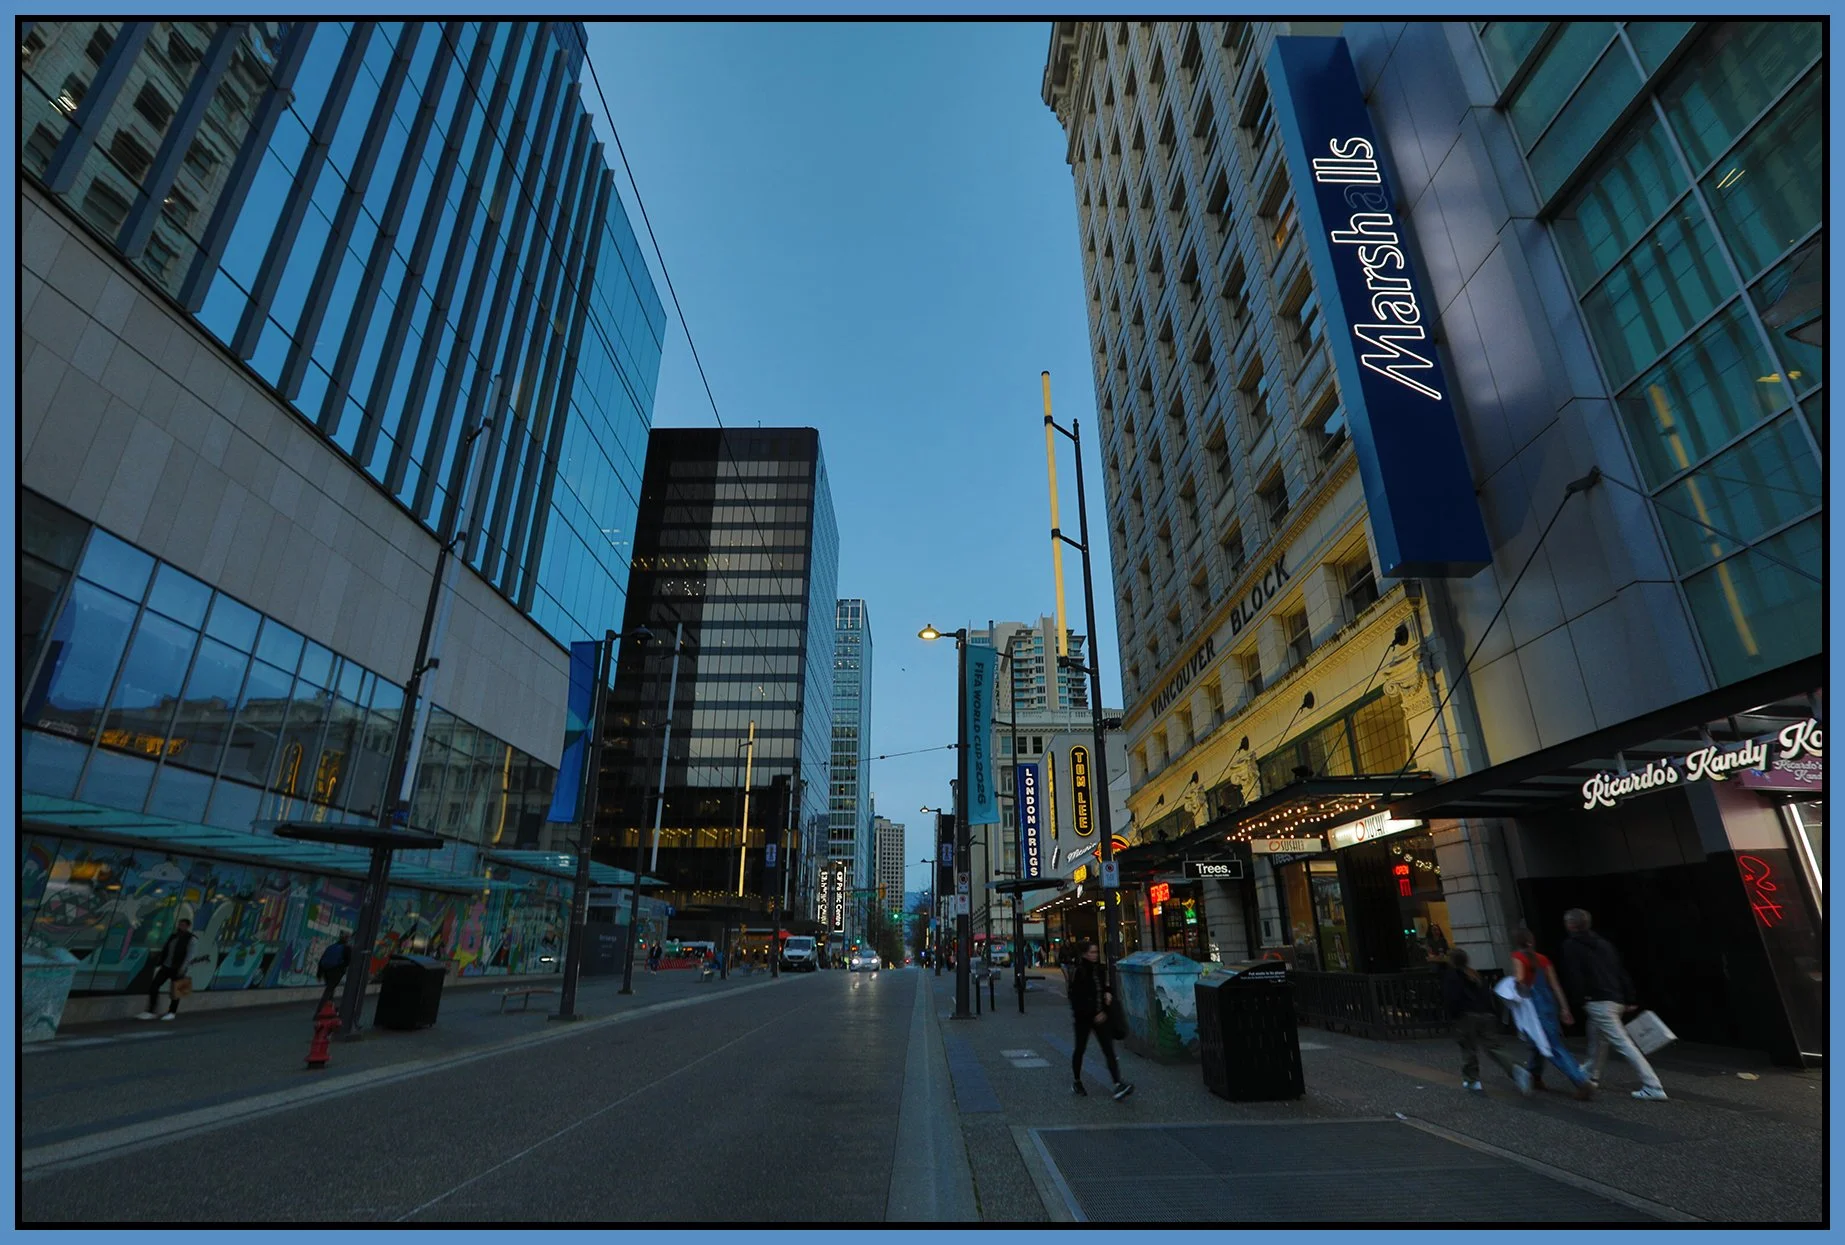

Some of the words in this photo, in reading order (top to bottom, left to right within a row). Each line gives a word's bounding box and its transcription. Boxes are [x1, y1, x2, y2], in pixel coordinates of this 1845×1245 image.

[1312, 136, 1442, 401] Marshalls
[1150, 637, 1216, 719] VANCOUVER
[1230, 554, 1291, 637] BLOCK
[973, 661, 985, 688] FIFA
[972, 690, 982, 733] WORLD
[973, 734, 983, 760] CUP
[974, 760, 986, 805] 2026
[1074, 751, 1087, 788] TOM
[1582, 759, 1679, 811] Ricardo's
[1686, 740, 1767, 782] Kandy
[1025, 767, 1037, 825] LONDON
[1077, 791, 1089, 829] LEE
[1027, 828, 1039, 877] DRUGS
[1195, 863, 1231, 874] Trees.
